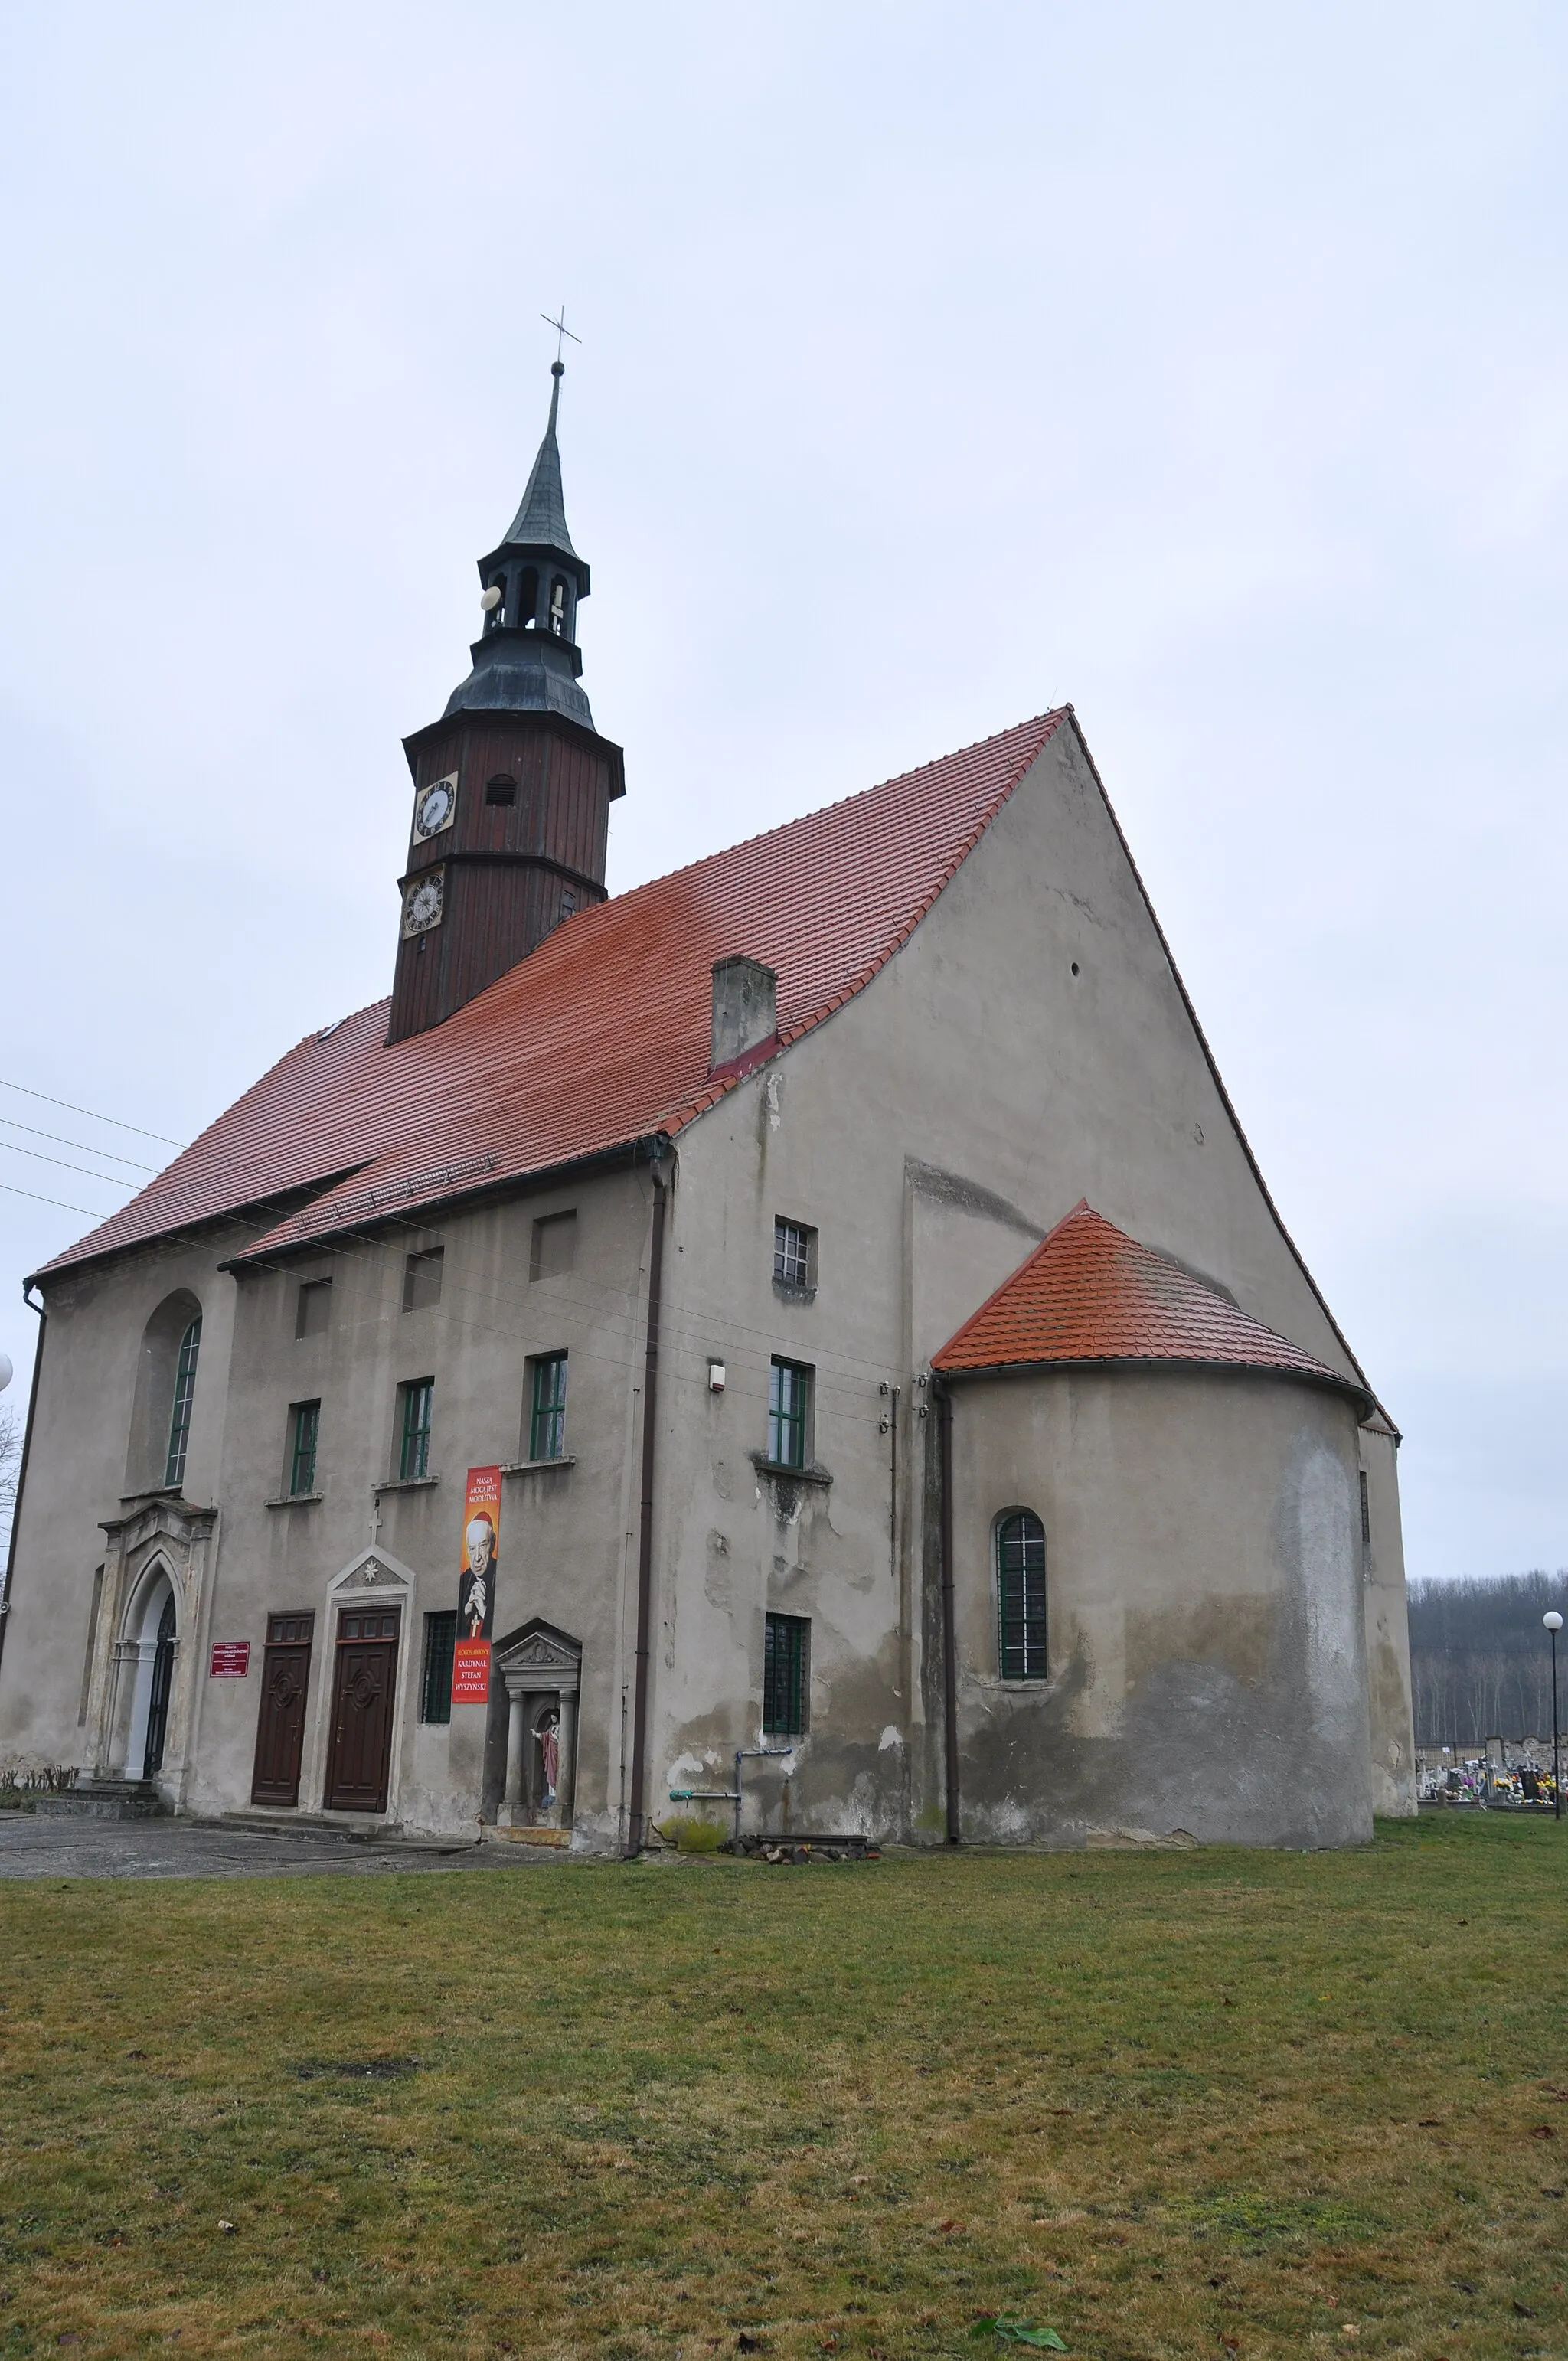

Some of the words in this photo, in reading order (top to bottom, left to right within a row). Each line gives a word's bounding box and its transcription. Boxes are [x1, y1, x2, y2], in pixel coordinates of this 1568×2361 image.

[486, 1484, 497, 1493] JEST
[469, 1494, 497, 1502] MODLITWA
[455, 1682, 486, 1691] WYSZYŃSKI
